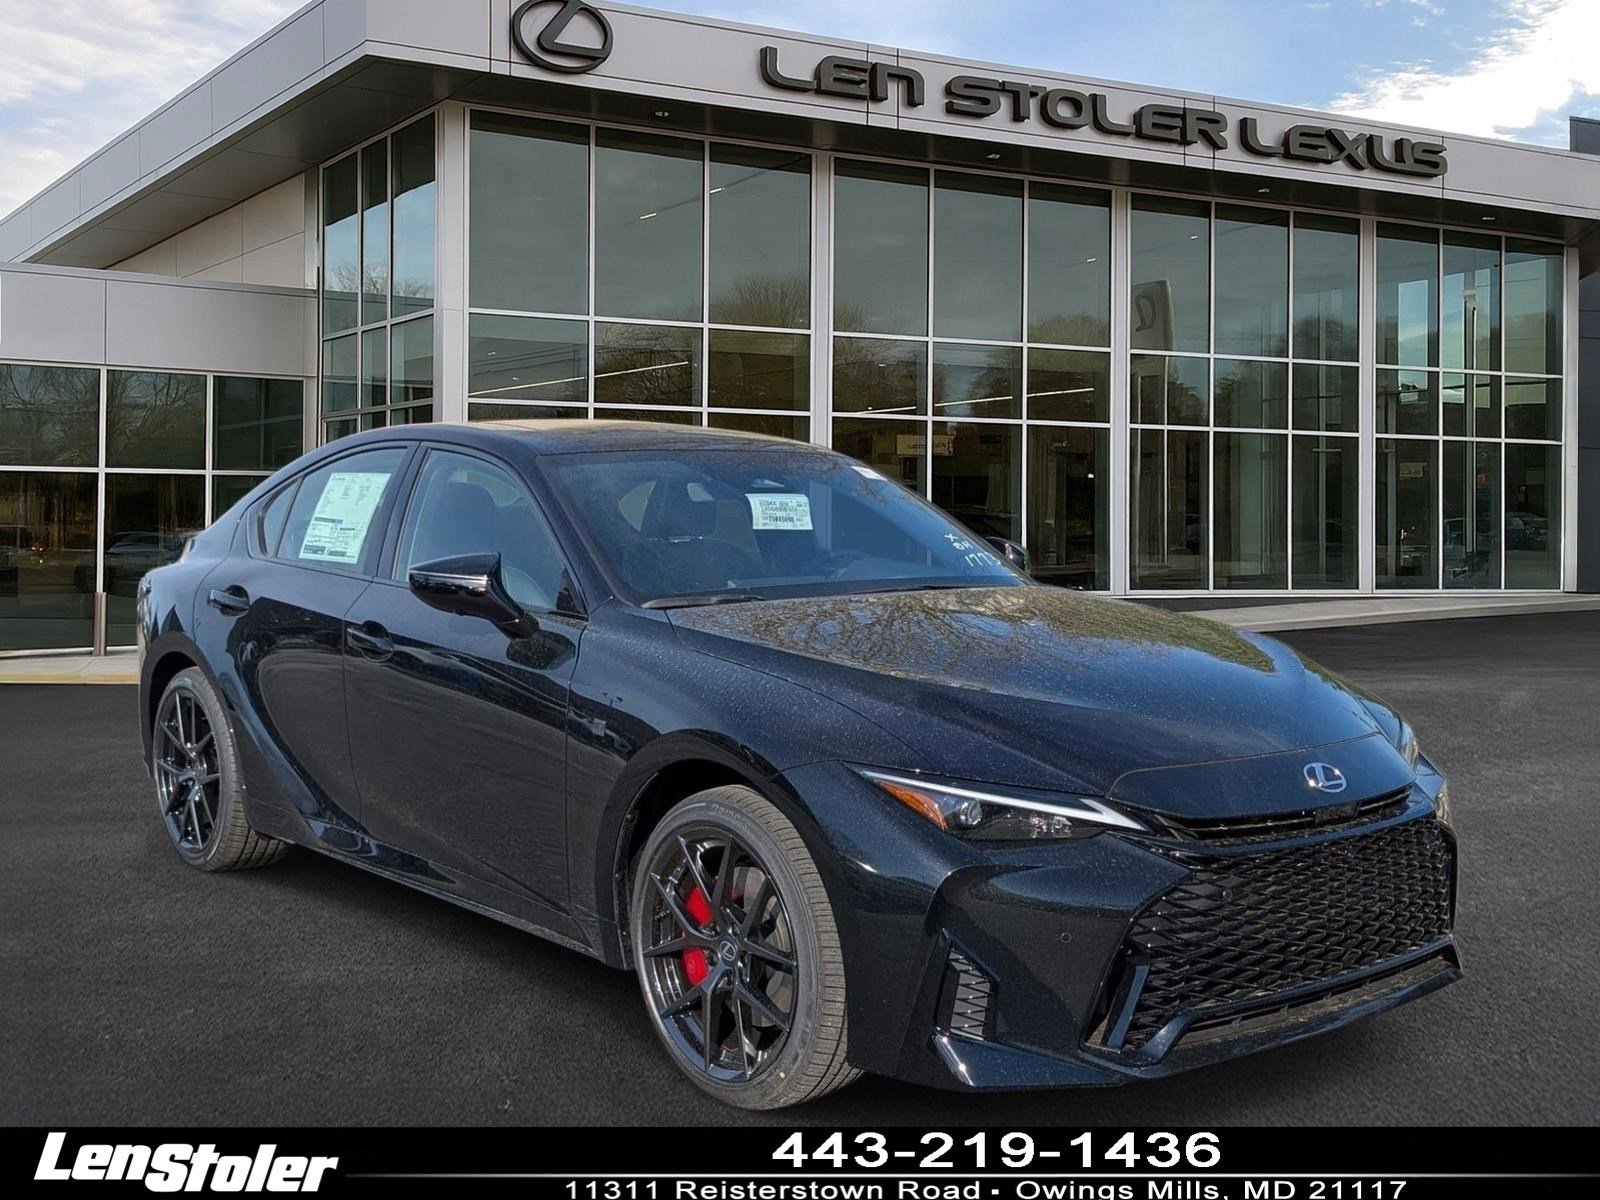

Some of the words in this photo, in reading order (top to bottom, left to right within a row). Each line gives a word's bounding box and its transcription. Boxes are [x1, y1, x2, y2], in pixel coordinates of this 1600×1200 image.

[760, 46, 925, 107] LEN
[945, 75, 1228, 151] STOLER
[1239, 117, 1448, 178] LEXUS
